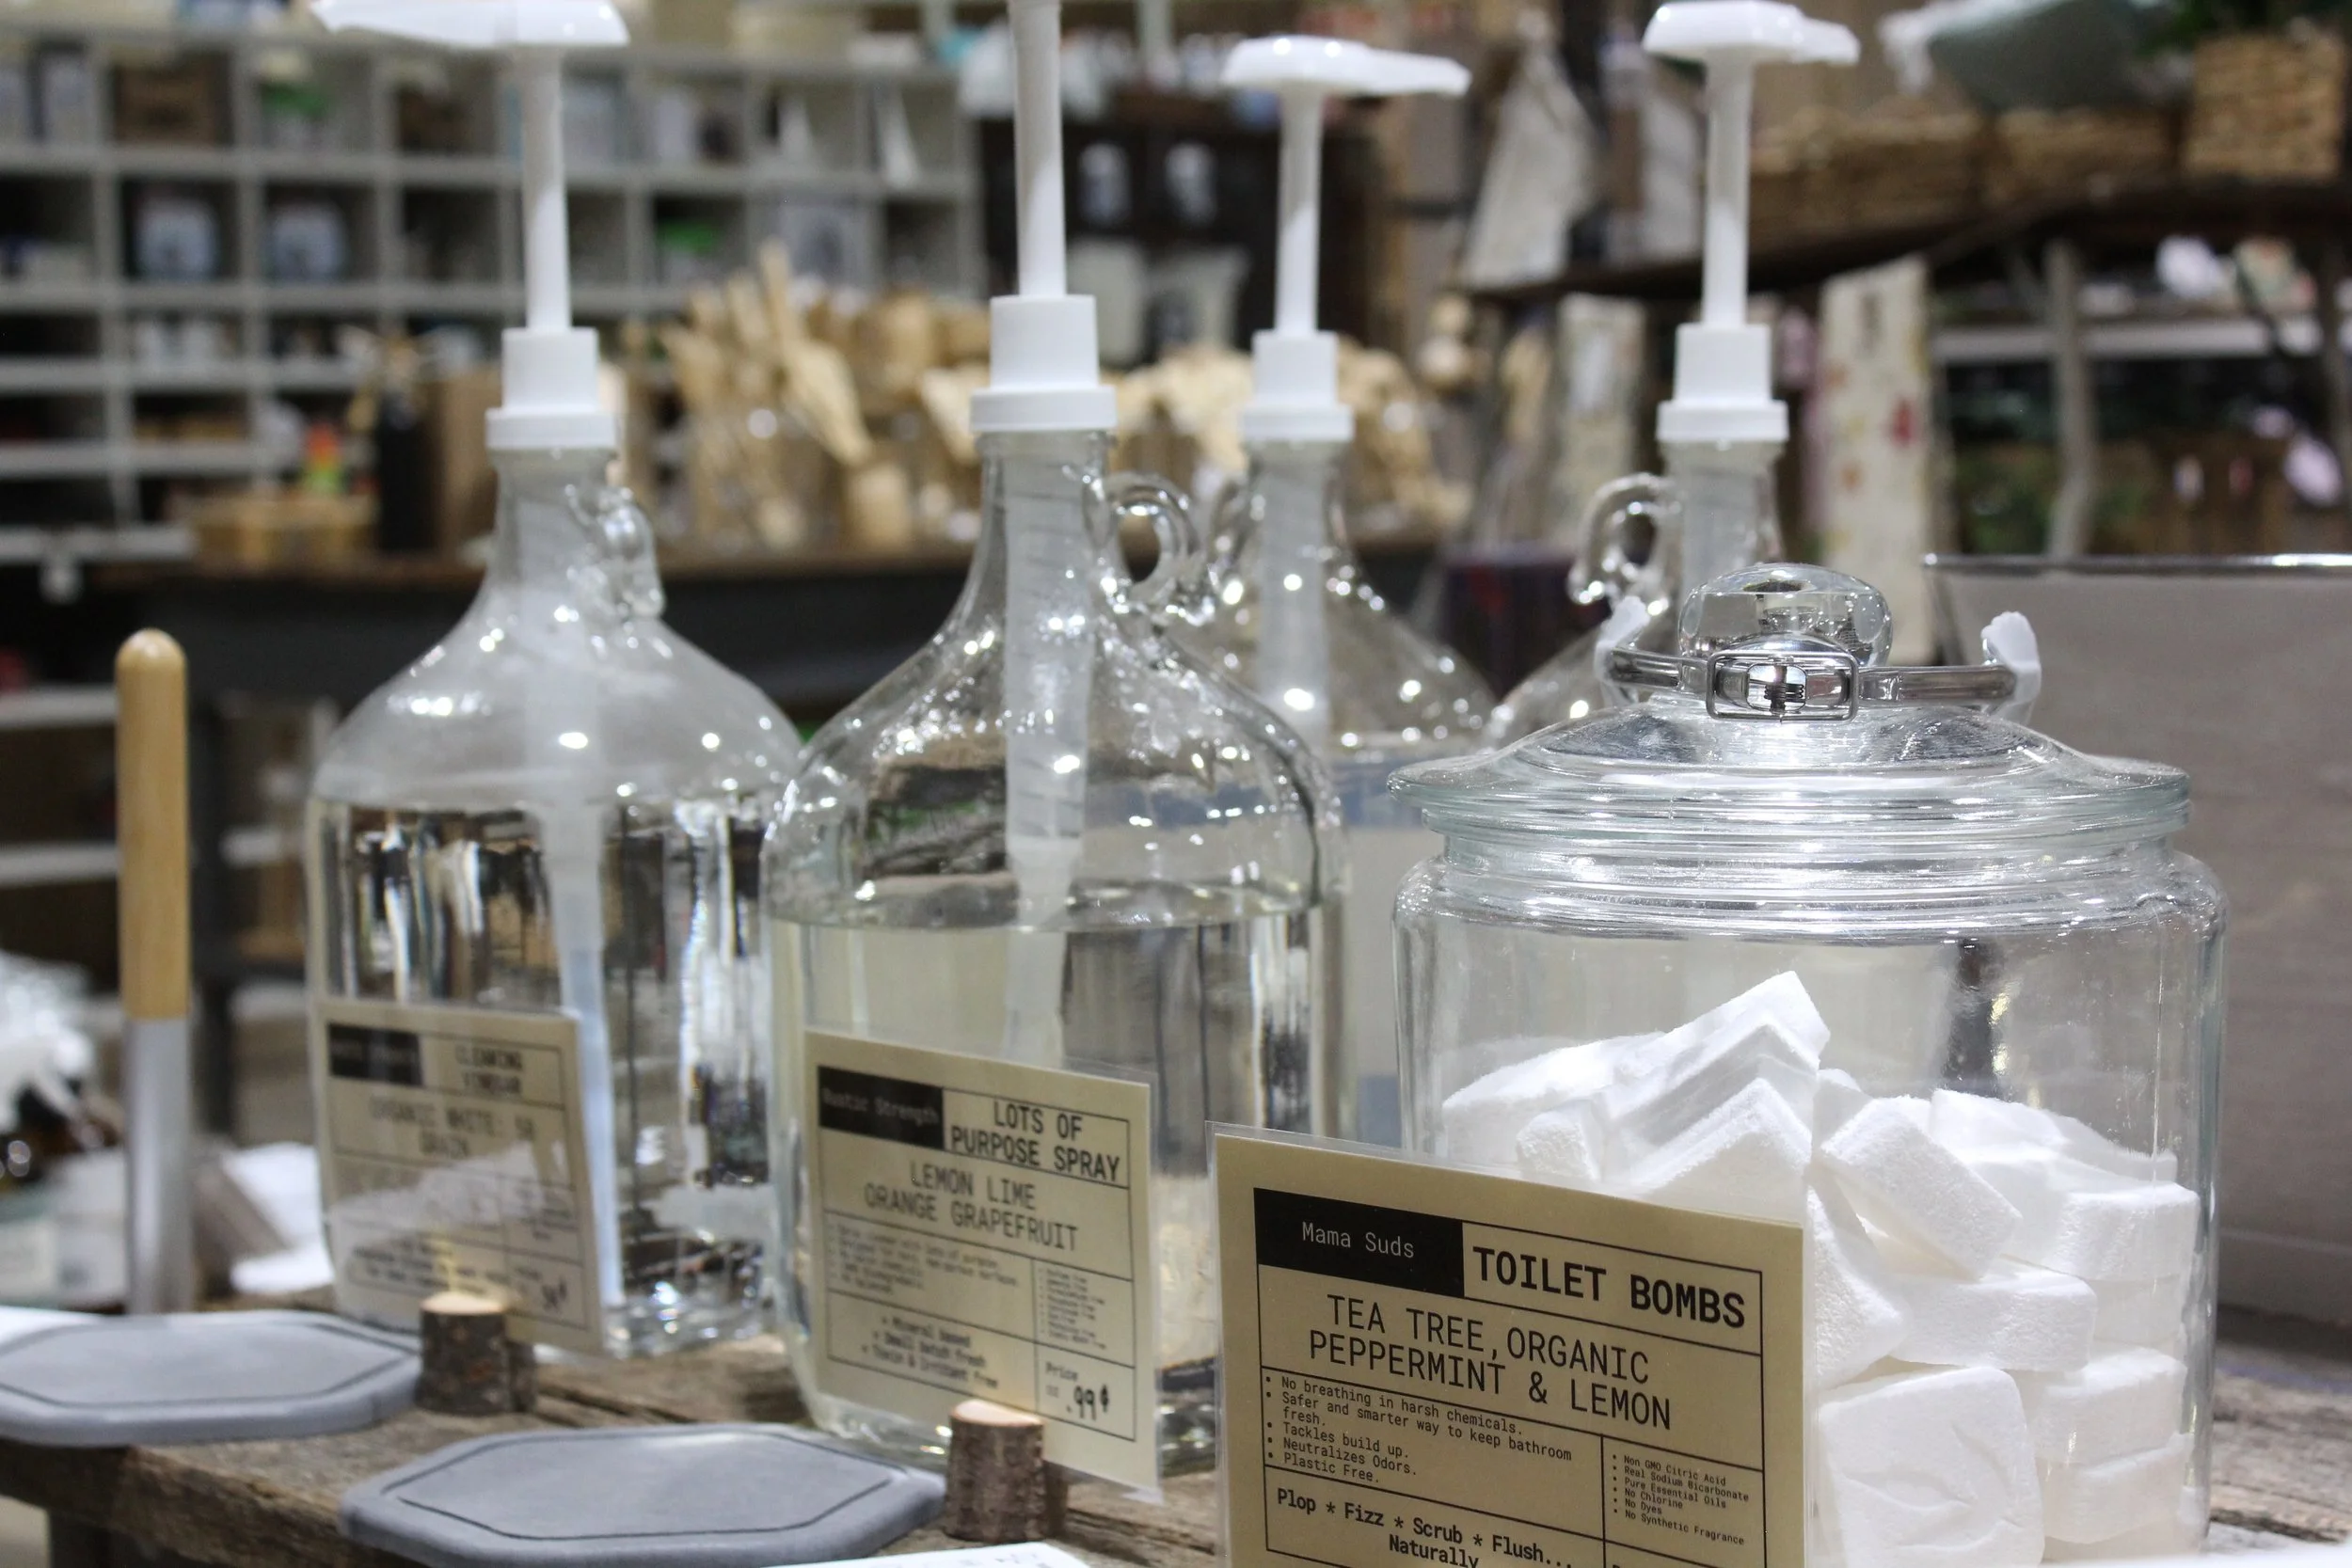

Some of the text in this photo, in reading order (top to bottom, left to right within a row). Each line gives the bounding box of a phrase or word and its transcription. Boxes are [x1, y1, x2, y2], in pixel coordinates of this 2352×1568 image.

[993, 1101, 1082, 1141] LOTS OF
[951, 1125, 1120, 1182] PURPOSE SPRAY
[910, 1160, 1036, 1211] LEMON LIME
[864, 1182, 939, 1222] ORANGE
[950, 1200, 1079, 1252] GRAPEFRUIT
[1302, 1222, 1414, 1259] Mama Suds
[1472, 1246, 1745, 1328] TOILET BOMBS
[1327, 1294, 1386, 1334] TEA
[1310, 1330, 1671, 1430] PEPPERMINT & LEMON
[1281, 1376, 1522, 1434] No breathing in harsh chemicals.
[1282, 1408, 1326, 1427] fresh.
[1282, 1391, 1572, 1461] Safer and smarter way to keep bathroom
[1283, 1422, 1408, 1459] Tackles build up.
[1283, 1437, 1417, 1475] Neutralizes Odors.
[1284, 1452, 1379, 1483] Plastic Free.
[1624, 1455, 1726, 1486] Non GMO Citric Acid
[1624, 1466, 1749, 1502] Real Sodium Bicarbonate
[1625, 1477, 1726, 1509] Pure Essential Oils
[1625, 1488, 1683, 1509] No Chlorine
[1278, 1488, 1316, 1513] Plop
[1344, 1503, 1384, 1527] Fizz
[1413, 1518, 1462, 1544] Scrub
[1625, 1498, 1662, 1514] No Dyes
[1626, 1510, 1744, 1545] No Synthetic Fragrance
[1390, 1534, 1479, 1568] Naturally
